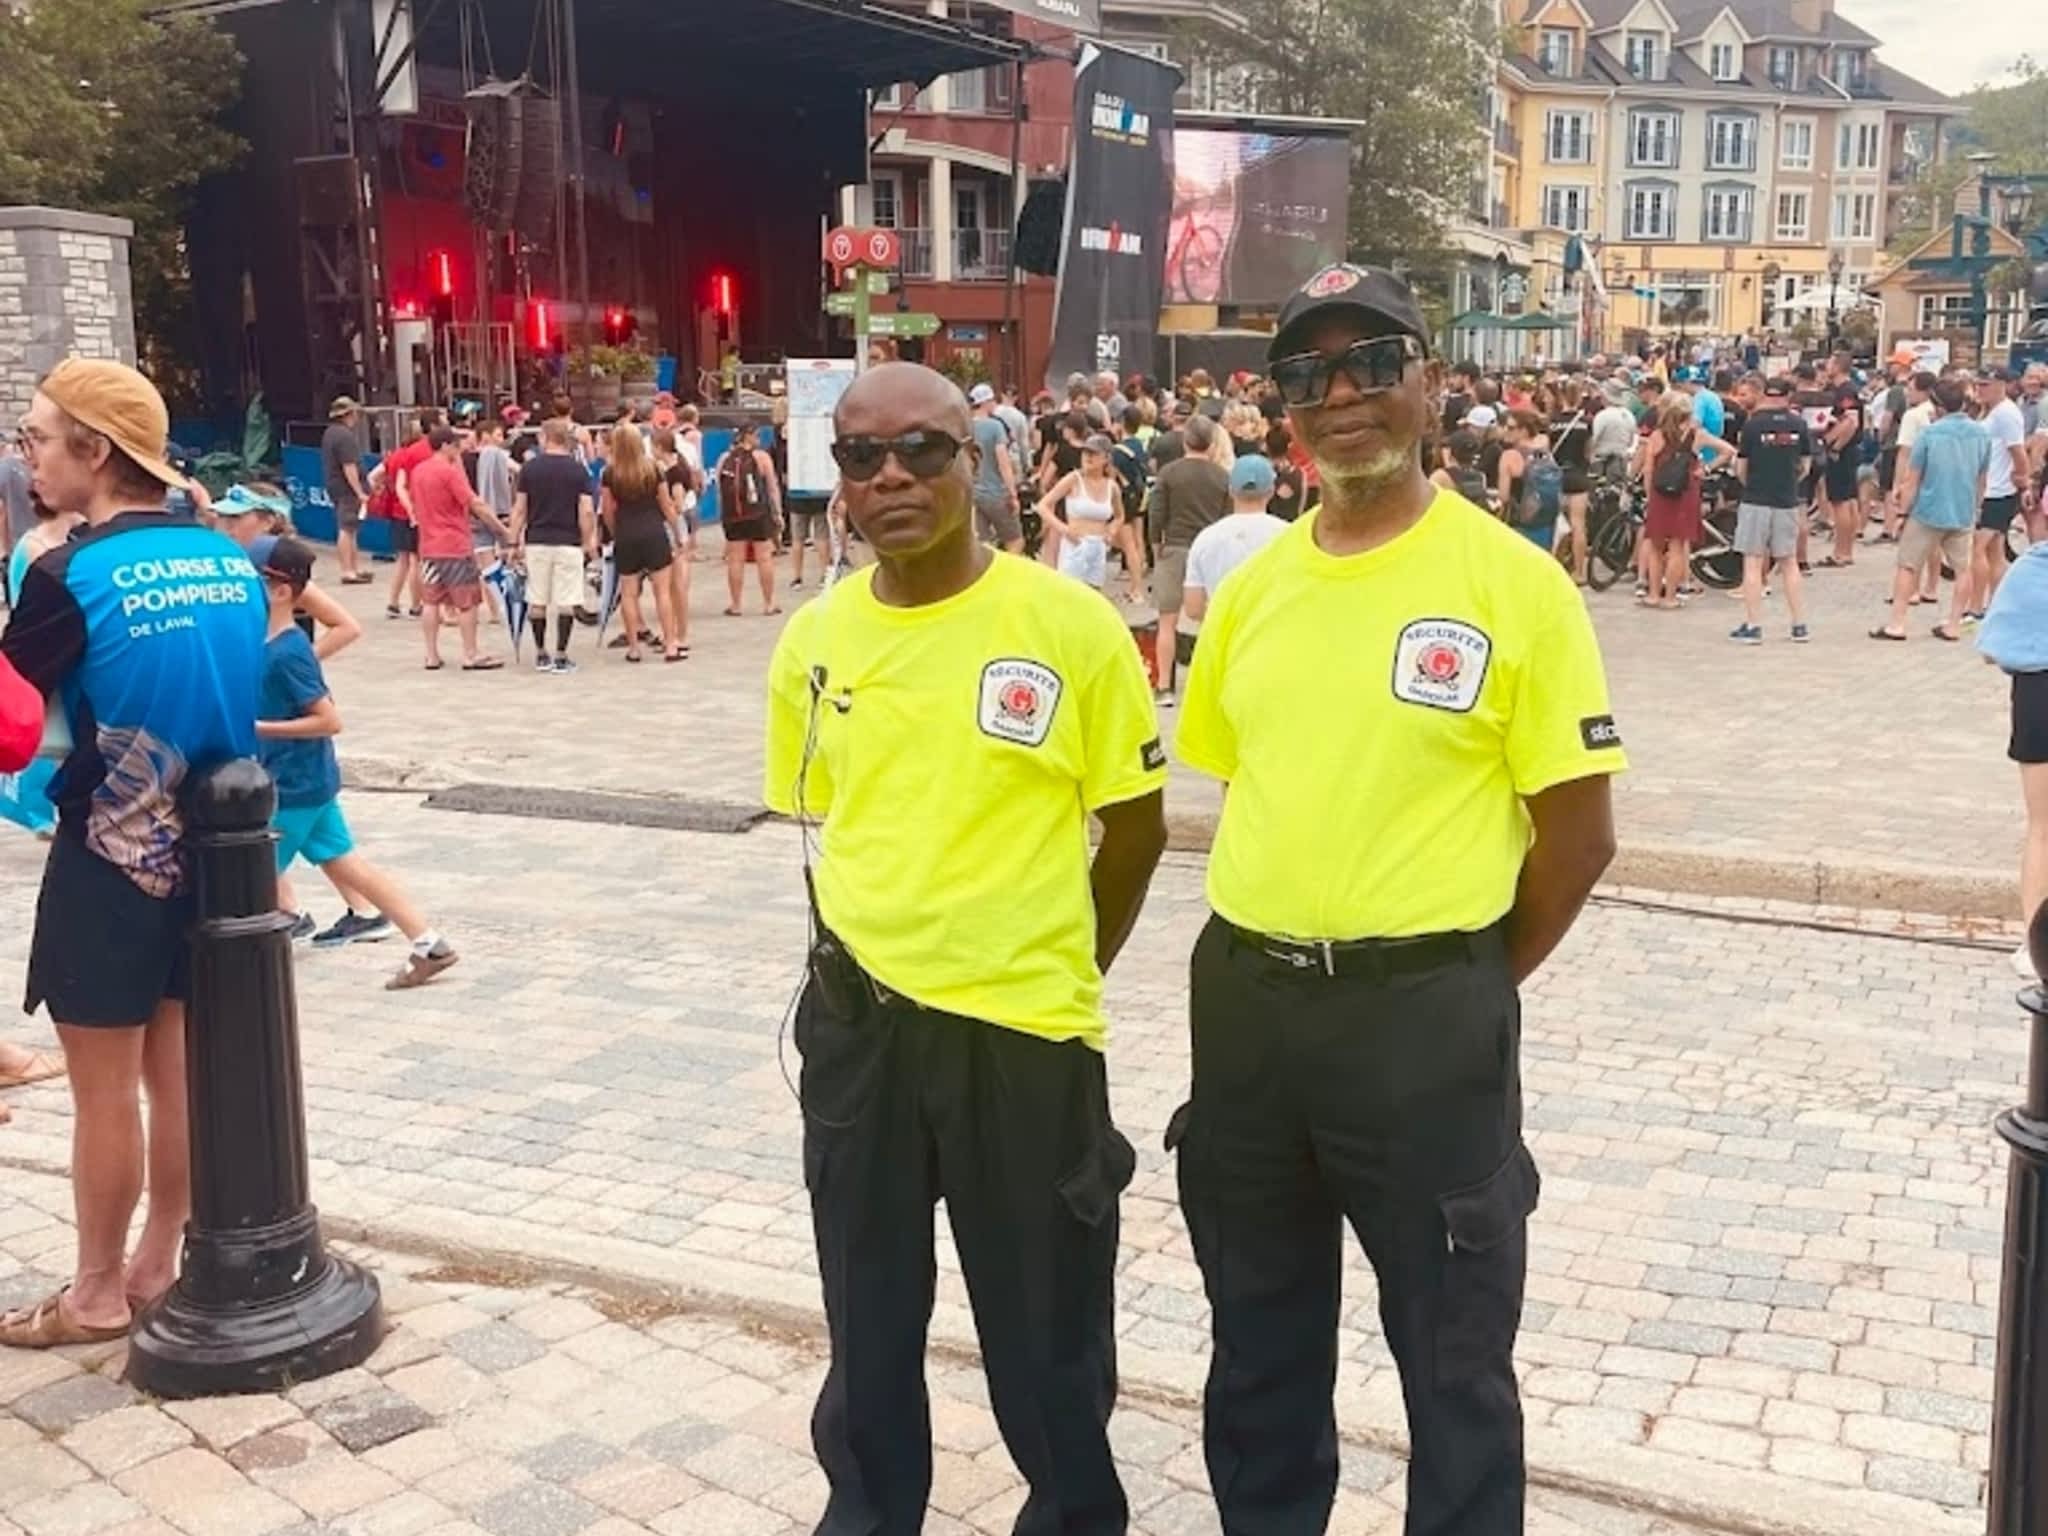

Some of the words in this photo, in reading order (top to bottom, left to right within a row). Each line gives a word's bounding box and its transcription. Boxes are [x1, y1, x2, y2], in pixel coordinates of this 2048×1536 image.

[1096, 334, 1120, 357] 50
[112, 557, 221, 588] COURSE
[122, 582, 248, 616] POMPIERS
[128, 622, 152, 638] DE
[154, 615, 197, 633] LAVAL
